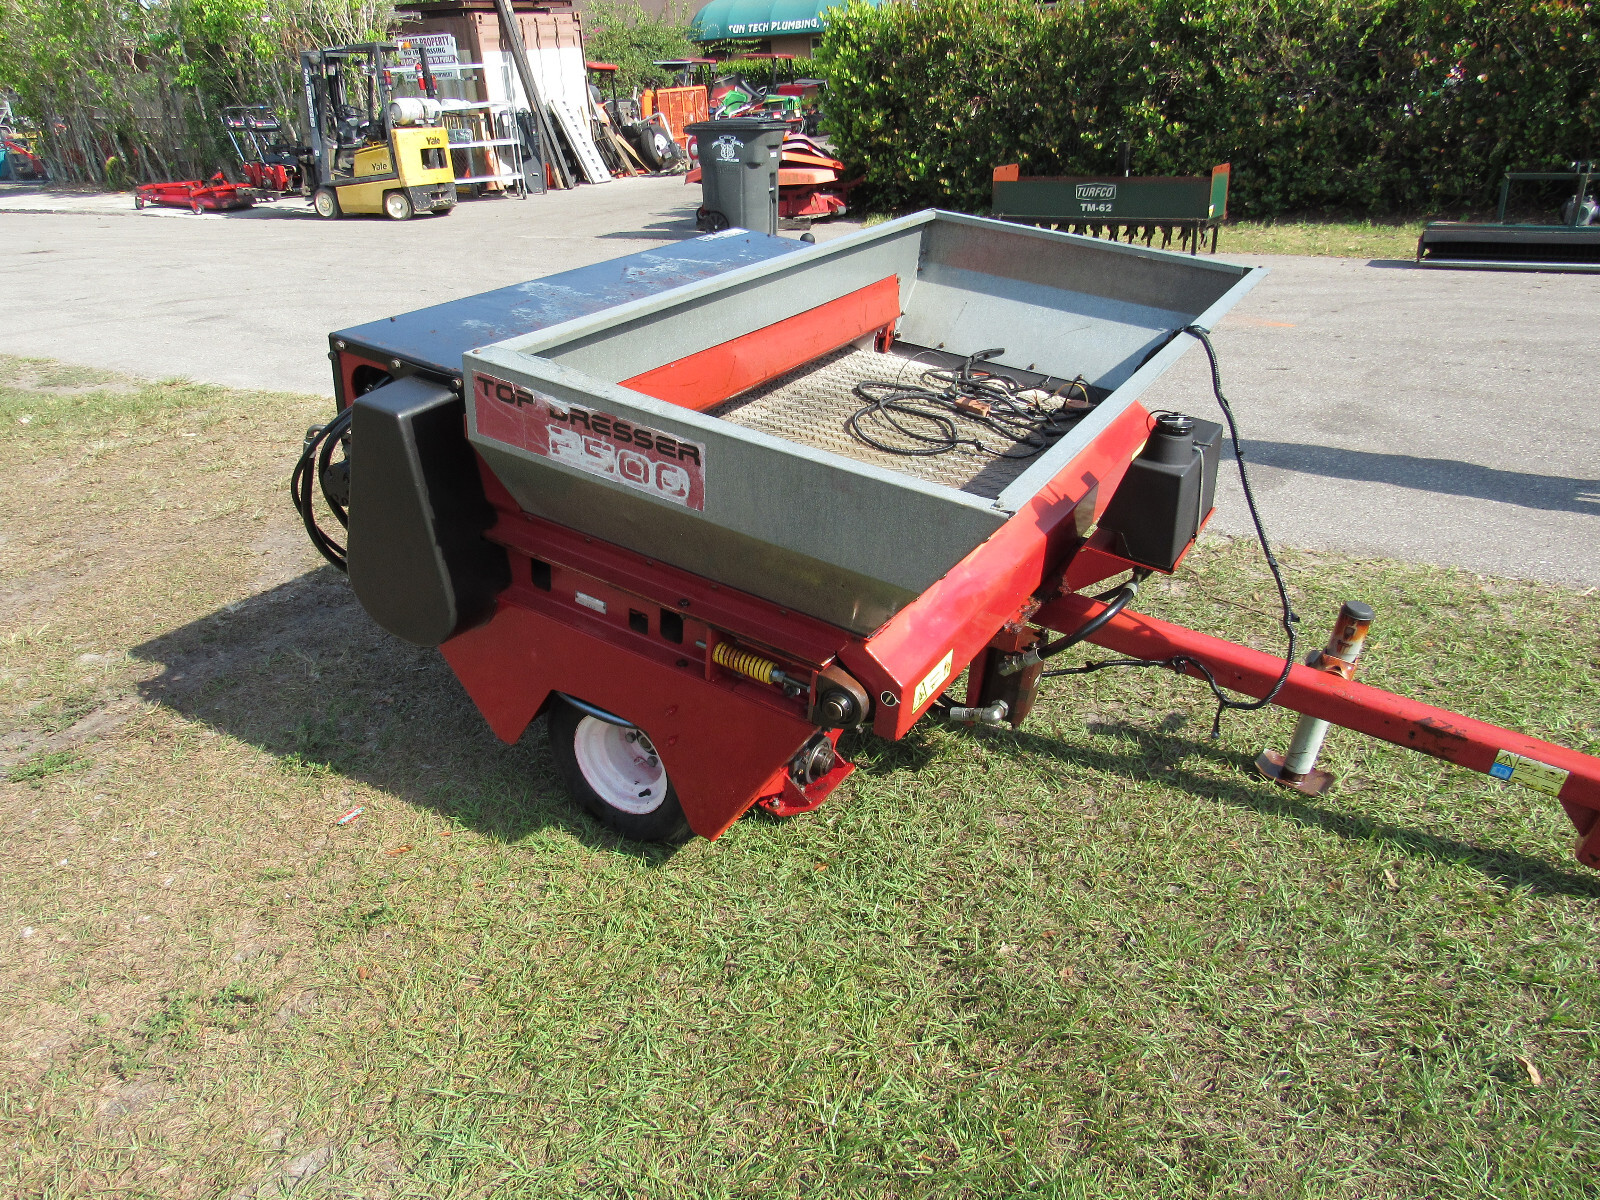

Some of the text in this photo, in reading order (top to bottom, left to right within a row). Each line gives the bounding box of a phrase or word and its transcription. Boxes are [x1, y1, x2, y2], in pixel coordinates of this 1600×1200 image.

[748, 22, 769, 33] TECH
[771, 18, 819, 31] PLUMBING,
[426, 136, 440, 145] Yale
[371, 162, 387, 171] Yale
[1077, 186, 1114, 197] TURFCO
[1080, 203, 1112, 212] TM-62
[477, 376, 535, 407] TOP
